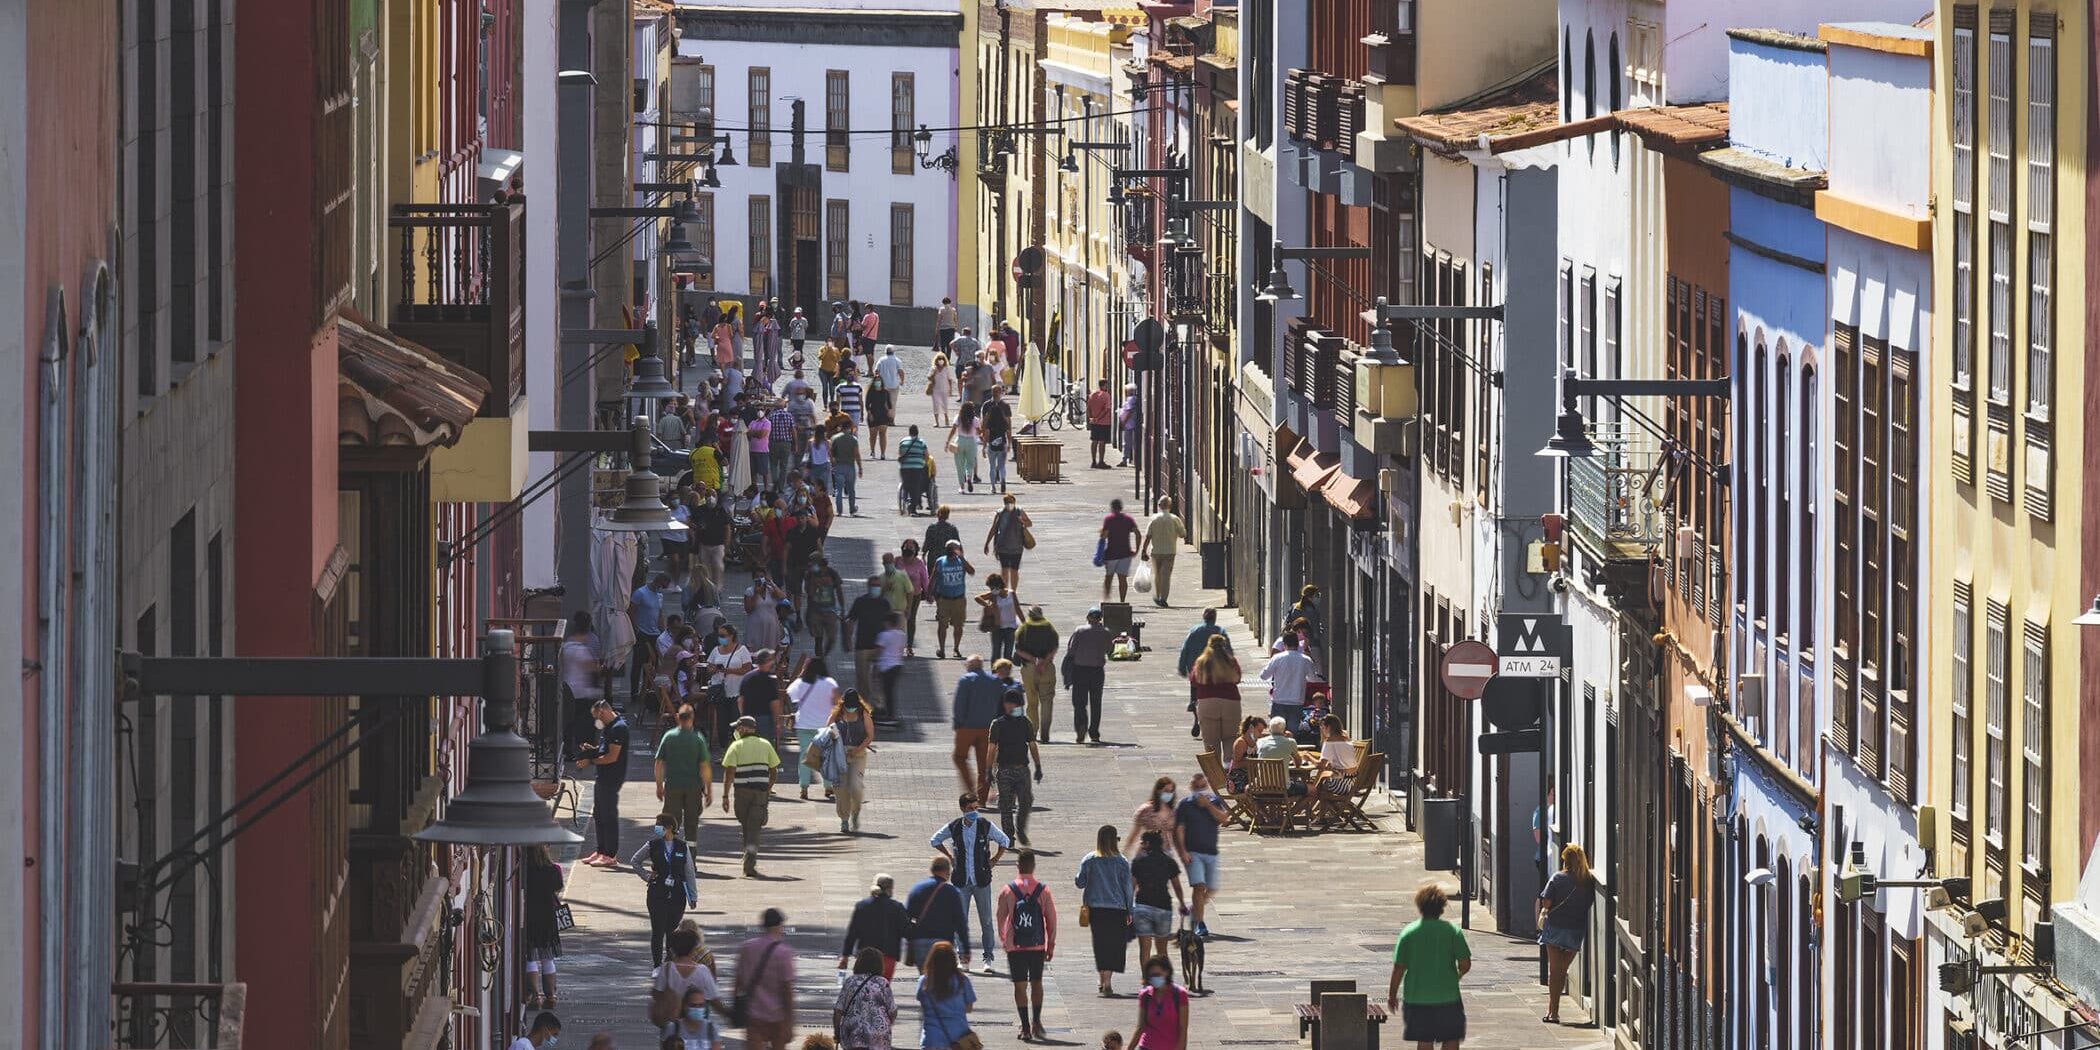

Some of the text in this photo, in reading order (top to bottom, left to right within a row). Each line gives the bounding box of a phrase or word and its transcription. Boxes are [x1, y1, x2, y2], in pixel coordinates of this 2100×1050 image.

[943, 571, 963, 582] NYC
[1505, 660, 1554, 672] ATM 24
[557, 914, 572, 930] AG
